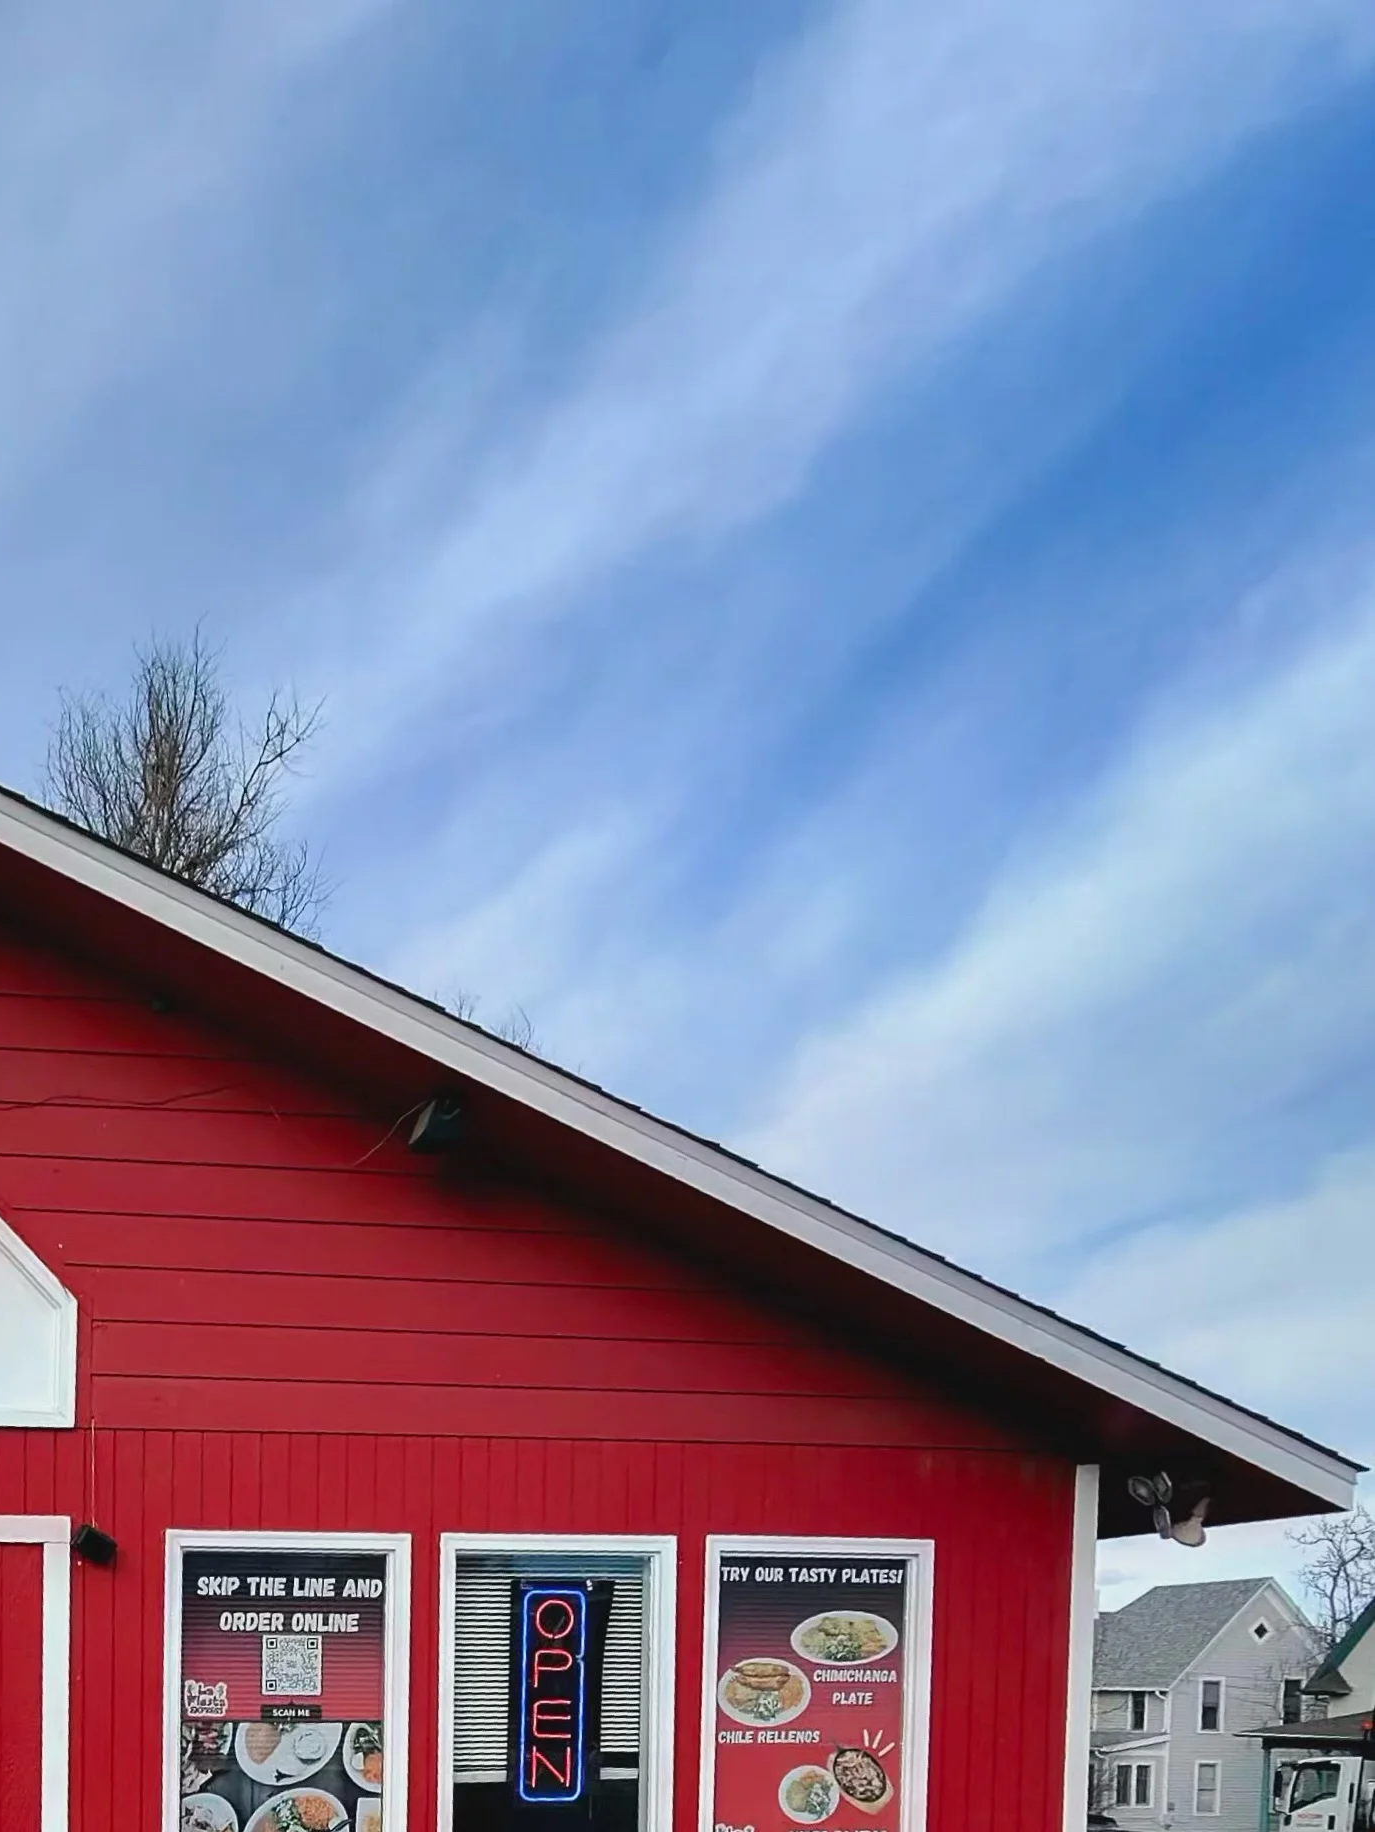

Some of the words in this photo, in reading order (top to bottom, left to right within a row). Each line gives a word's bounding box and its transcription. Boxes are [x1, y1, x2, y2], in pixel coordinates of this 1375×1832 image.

[721, 1566, 750, 1582] TRY
[754, 1566, 783, 1582] OUR
[788, 1567, 836, 1583] TASTY
[842, 1567, 903, 1584] PLATES!
[197, 1577, 240, 1597] SKIP
[247, 1577, 286, 1597] THE
[293, 1578, 336, 1597] LINE
[342, 1578, 383, 1598] AND
[220, 1612, 284, 1632] ORDER
[291, 1613, 360, 1633] ONLINE
[813, 1668, 897, 1683] CHIMICHANGA
[531, 1599, 575, 1788] OPEN
[832, 1691, 873, 1705] PLATE
[272, 1709, 296, 1717] SCAN
[297, 1709, 310, 1717] ME
[718, 1730, 753, 1744] CHILE
[757, 1730, 821, 1744] RELLENOS
